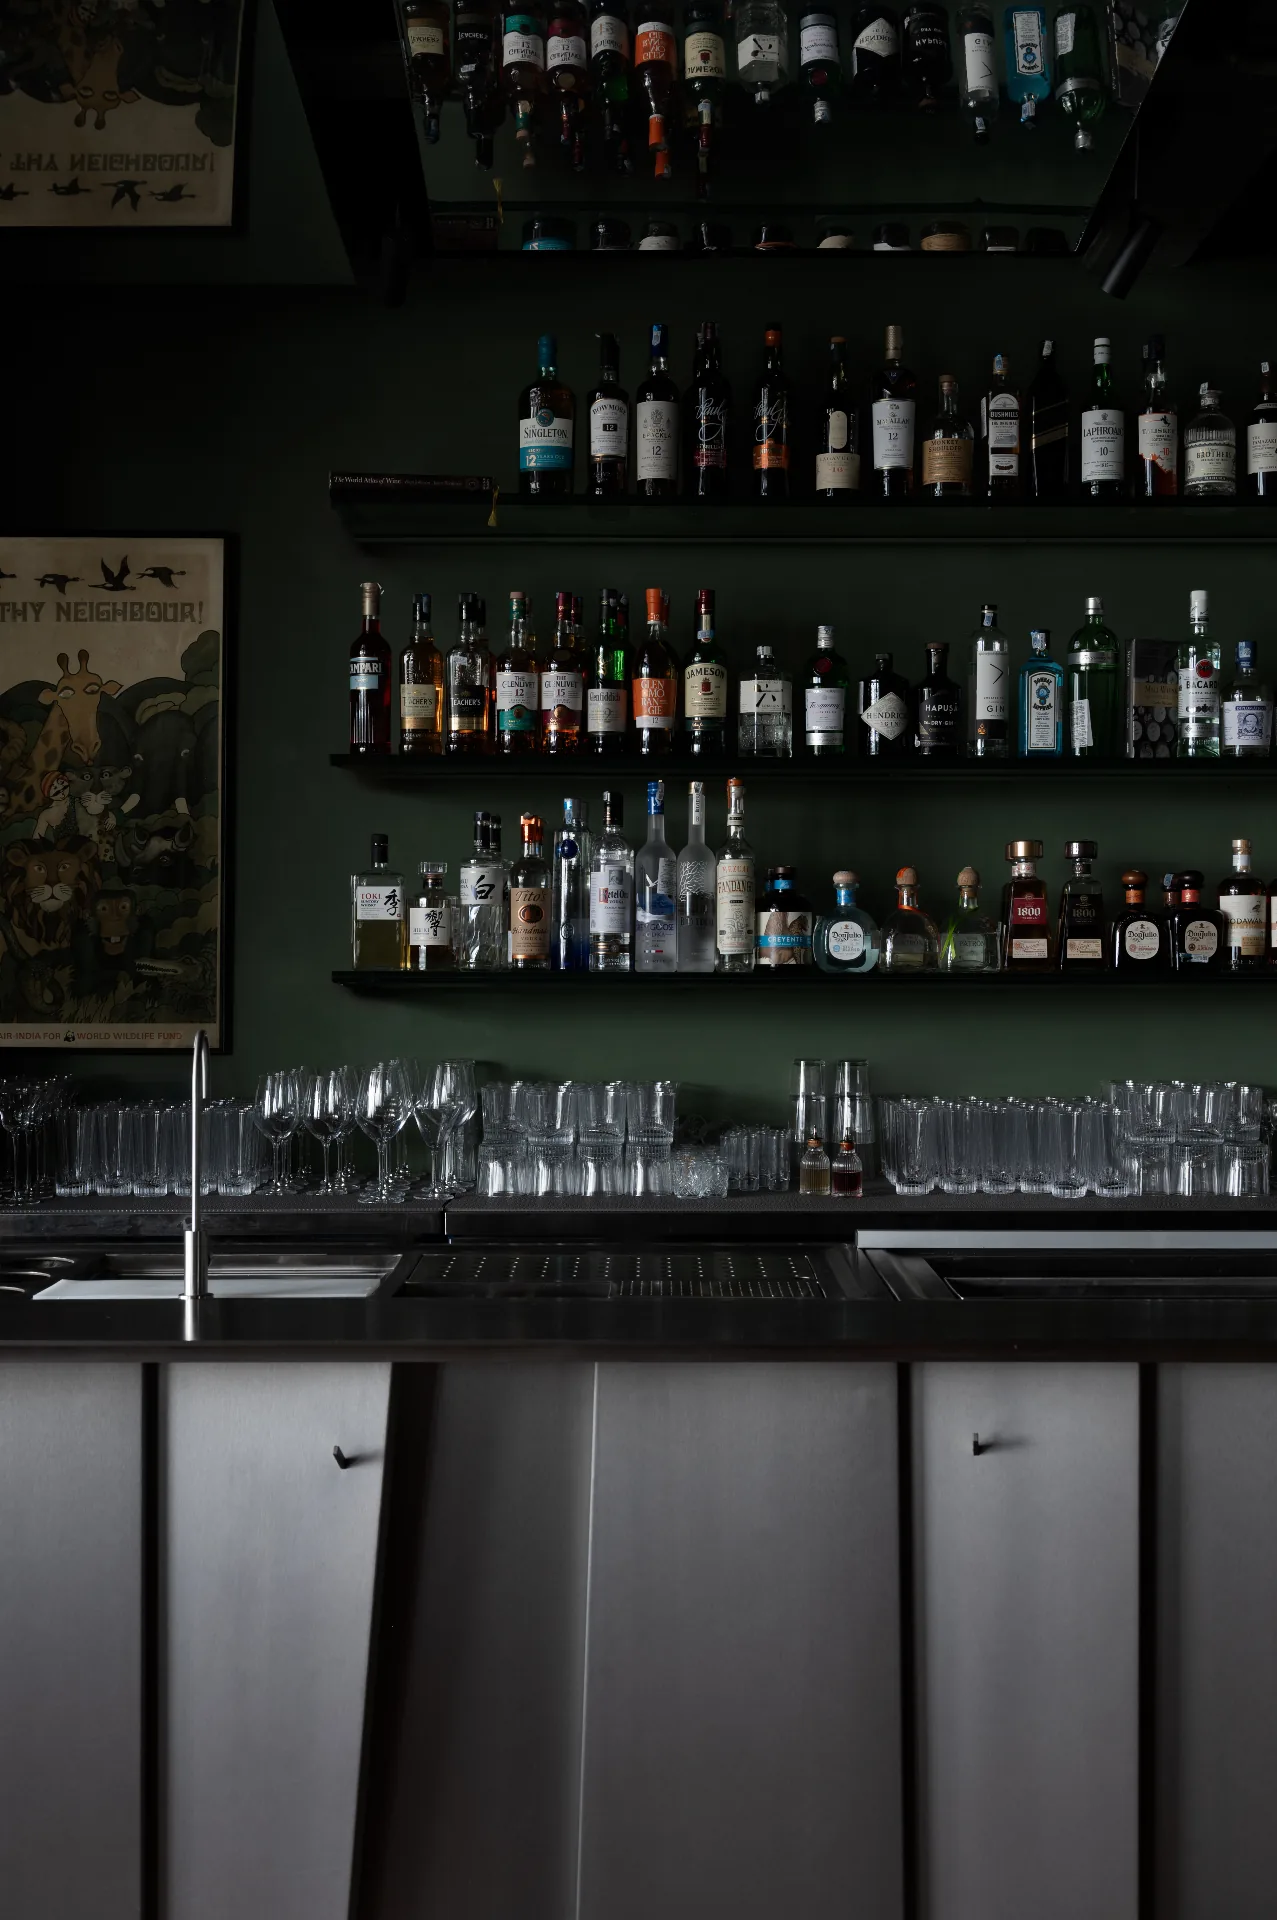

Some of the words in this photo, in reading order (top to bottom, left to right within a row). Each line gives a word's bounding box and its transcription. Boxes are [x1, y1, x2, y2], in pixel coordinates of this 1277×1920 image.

[592, 404, 627, 415] BOWMORE
[990, 411, 1019, 419] BUSHMILLS
[524, 428, 568, 441] SINGLETON
[888, 432, 899, 441] 12
[931, 439, 959, 447] MONKEY
[651, 445, 662, 456] 12
[1099, 446, 1109, 456] 10
[526, 455, 537, 467] 12
[0, 601, 45, 622] THY
[56, 600, 204, 624] NEIGHBOUR!
[686, 667, 725, 680] JAMESON
[502, 681, 535, 689] GLENLIVET
[641, 680, 664, 689] GLEN
[450, 697, 482, 707] TEACHER'S
[641, 698, 659, 706] RAN
[648, 706, 663, 715] GIE
[987, 705, 1005, 713] GIN
[474, 874, 496, 901] 白
[515, 889, 548, 902] Tito's
[384, 889, 401, 916] 季
[1017, 907, 1041, 917] 1800
[1072, 908, 1096, 918] 1800
[650, 923, 675, 931] GOOSE
[43, 1032, 61, 1040] FOR
[77, 1032, 111, 1041] WORLD
[113, 1032, 155, 1041] WILDLIFE
[158, 1032, 183, 1041] FUND
